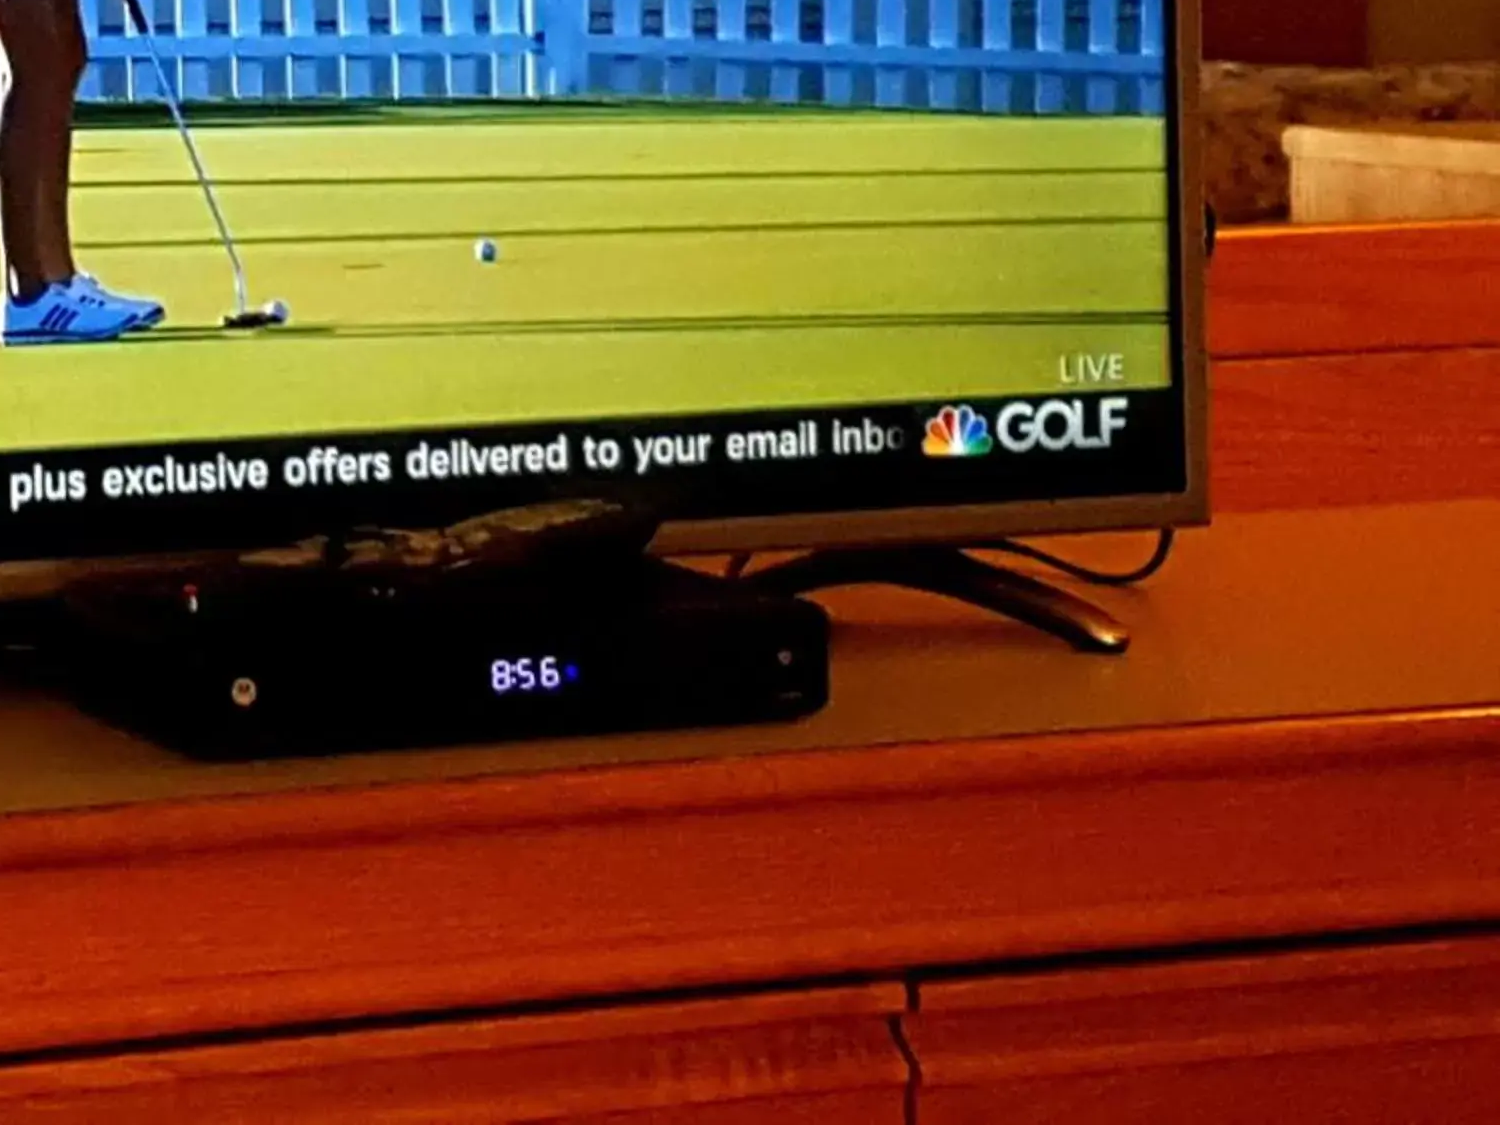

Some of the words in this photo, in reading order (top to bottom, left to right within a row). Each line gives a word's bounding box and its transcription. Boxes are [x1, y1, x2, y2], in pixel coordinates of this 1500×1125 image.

[1059, 353, 1124, 382] LIVE
[995, 396, 1129, 452] GOLF
[9, 462, 87, 513] plus
[101, 452, 269, 498] exclusive
[283, 446, 392, 487] offers
[405, 433, 569, 480] delivered
[582, 435, 621, 469] to
[633, 434, 712, 475] your
[725, 420, 818, 461] email
[491, 656, 560, 692] 8:56
